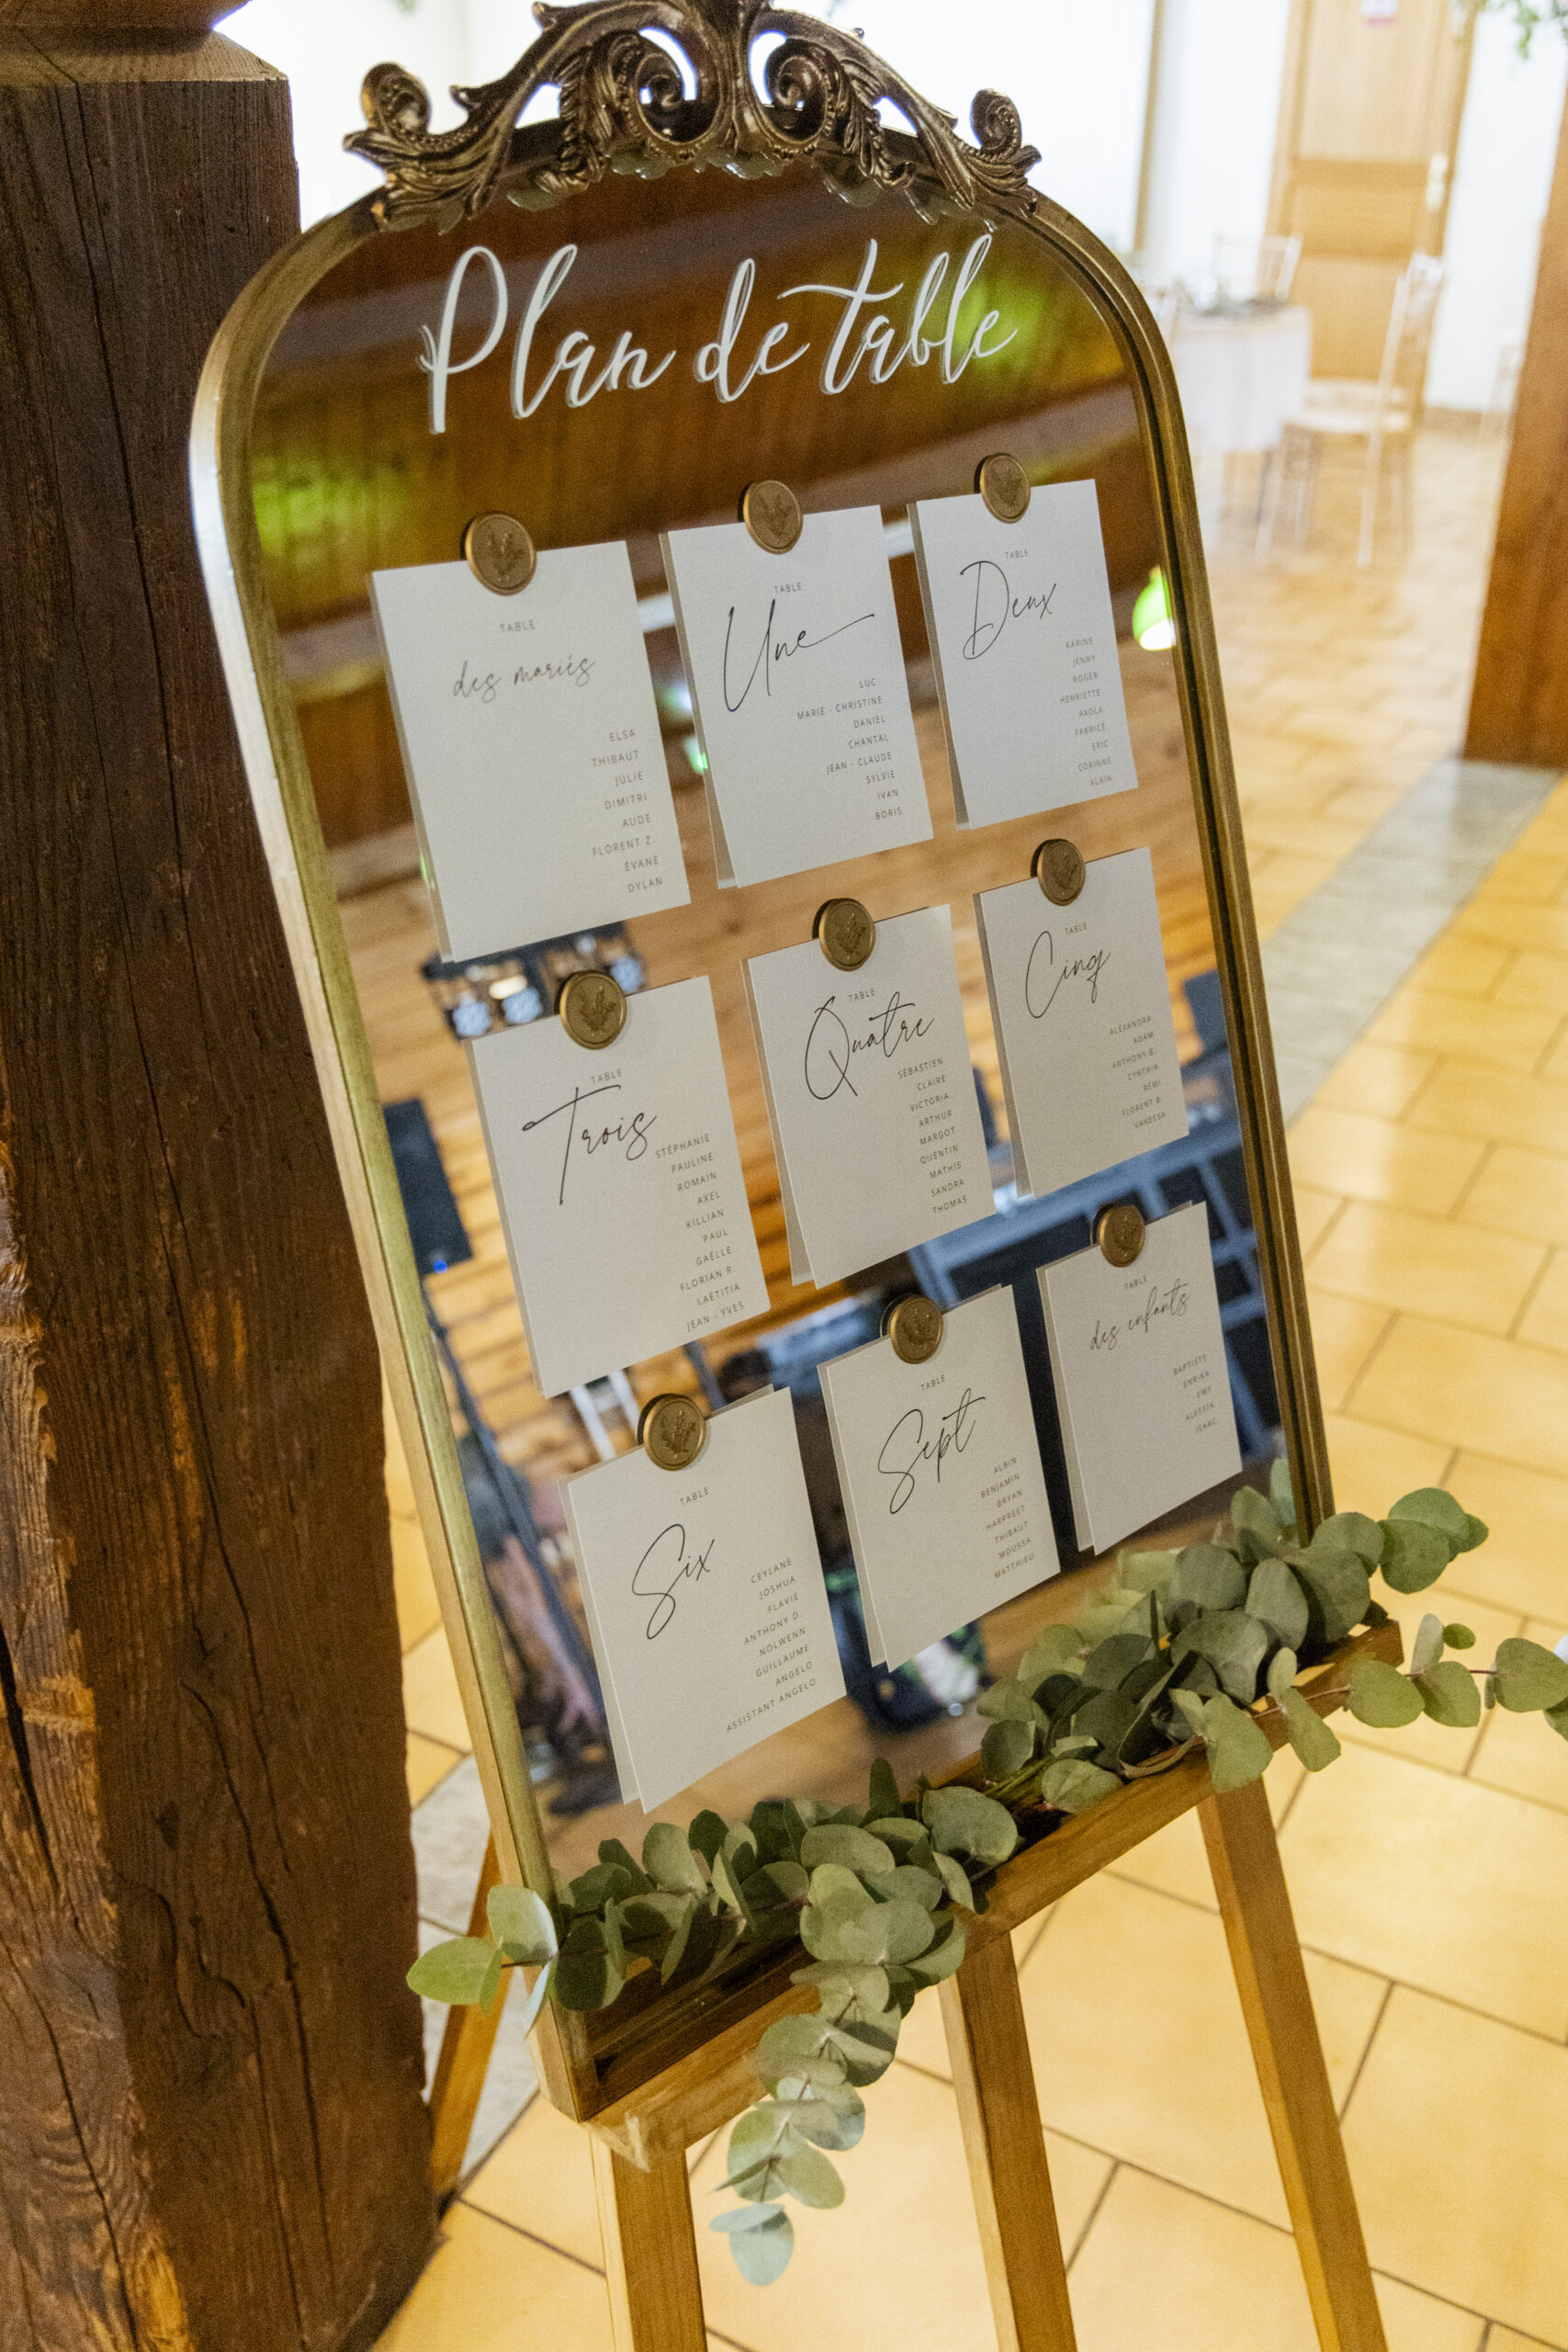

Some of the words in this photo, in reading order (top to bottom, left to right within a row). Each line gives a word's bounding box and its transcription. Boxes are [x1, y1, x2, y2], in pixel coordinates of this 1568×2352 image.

[421, 245, 675, 434] Plan
[694, 258, 810, 403] de
[779, 233, 1018, 394] table
[1005, 549, 1029, 560] TABLE
[773, 582, 802, 594] TABLE
[959, 560, 1056, 660] Deux
[499, 619, 536, 633] TABLE
[1066, 638, 1093, 649] KARINE
[724, 599, 875, 712] Une
[1072, 655, 1096, 667] JENNY
[453, 662, 501, 703] des
[514, 654, 595, 688] mariés
[859, 678, 876, 688] LUC
[1073, 672, 1098, 684] ROGER
[1060, 689, 1100, 704] HENRIETTE
[797, 707, 825, 720] MARIE
[836, 696, 883, 712] CHRISTINE
[1079, 707, 1102, 717] PAOLA
[853, 716, 886, 729] DANIEL
[1075, 723, 1106, 736] FABRICE
[609, 729, 636, 742] ELSA
[848, 734, 888, 749] CHANTAL
[1092, 740, 1108, 750] ERIC
[592, 751, 638, 767] THIBAUT
[826, 762, 847, 775] JEAN
[858, 752, 892, 765] CLAUDE
[1078, 757, 1111, 772] CORINNE
[614, 772, 644, 786] JULIE
[866, 771, 896, 784] SYLVIE
[1090, 775, 1111, 786] ALAIN
[604, 793, 648, 809] DIMITRI
[877, 789, 898, 800] IVAN
[622, 813, 651, 828] AUDE
[875, 808, 902, 820] BORIS
[592, 839, 640, 857] FLORENT
[627, 876, 662, 893] DYLAN
[1065, 922, 1088, 935] TABLE
[849, 988, 875, 1002] TABLE
[805, 991, 935, 1100] Quatre
[591, 1069, 623, 1085] TABLE
[917, 1075, 946, 1091] CLAIRE
[909, 1092, 949, 1112] VICTORIA
[919, 1110, 953, 1126] ARTHUR
[522, 1084, 657, 1205] Trois
[919, 1126, 955, 1145] MARGOT
[671, 1152, 714, 1173] PAULINE
[920, 1145, 958, 1164] QUENTIN
[930, 1161, 962, 1179] MATHIS
[677, 1171, 717, 1191] ROMAIN
[931, 1179, 964, 1197] SANDRA
[697, 1191, 720, 1204] AXEL
[932, 1195, 967, 1214] THOMAS
[686, 1209, 724, 1228] KILLIAN
[703, 1227, 728, 1242] PAUL
[679, 1270, 722, 1292] FLORIAN
[1124, 1275, 1147, 1290] TABLE
[686, 1315, 710, 1332] JEAN
[720, 1301, 744, 1317] YVES
[1090, 1320, 1122, 1351] des
[1128, 1278, 1190, 1333] enfants
[920, 1374, 946, 1391] TABLE
[878, 1388, 986, 1514] Sept
[993, 1457, 1017, 1474] ALBIN
[980, 1474, 1021, 1499] BENJAMIN
[680, 1487, 709, 1506] TABLE
[997, 1489, 1022, 1508] BRYAN
[994, 1521, 1029, 1544] THIBAUT
[998, 1537, 1032, 1559] MOUSSA
[750, 1558, 793, 1584] CEYLANE
[994, 1553, 1034, 1579] MATTHIEU
[632, 1523, 715, 1639] Six
[759, 1575, 795, 1600] JOSHUA
[768, 1592, 799, 1613] FLAVIE
[743, 1617, 789, 1645] ANTHONY
[759, 1627, 807, 1657] NOLWENN
[756, 1644, 809, 1678] GUILLAUME
[775, 1661, 813, 1686] ANGELO
[727, 1700, 775, 1733] ASSISTANT
[779, 1678, 816, 1702] ANGELO
